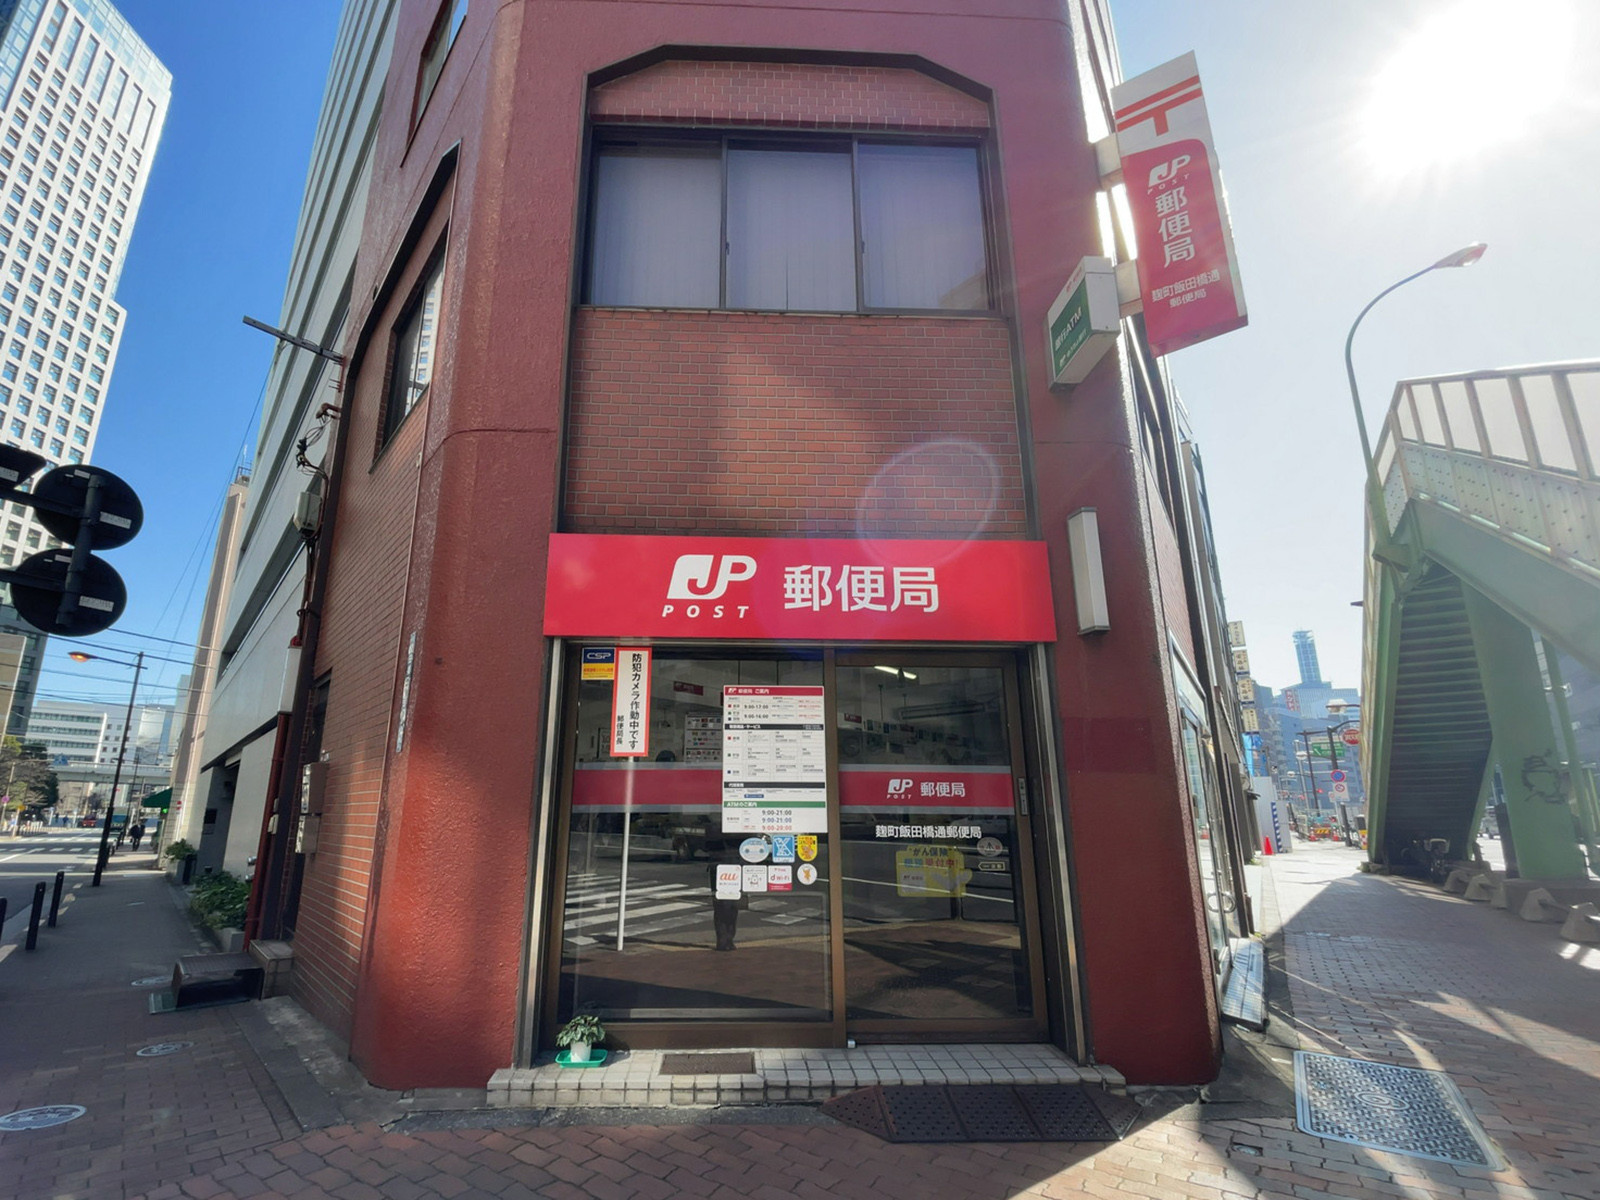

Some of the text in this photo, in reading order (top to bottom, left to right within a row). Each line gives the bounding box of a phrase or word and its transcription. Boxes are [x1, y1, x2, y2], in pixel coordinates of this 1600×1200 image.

[1148, 154, 1191, 187] JP
[1147, 173, 1190, 195] POST
[1155, 186, 1196, 268] 郵便局
[1169, 288, 1207, 308] 郵便局
[666, 554, 940, 613] JP 郵便局
[662, 605, 749, 618] POST
[586, 652, 611, 660] CSP
[628, 653, 642, 750] 防犯カメラ作動中です
[616, 715, 624, 744] 郵便局長
[888, 779, 966, 797] JP 郵便局
[720, 872, 738, 881] au
